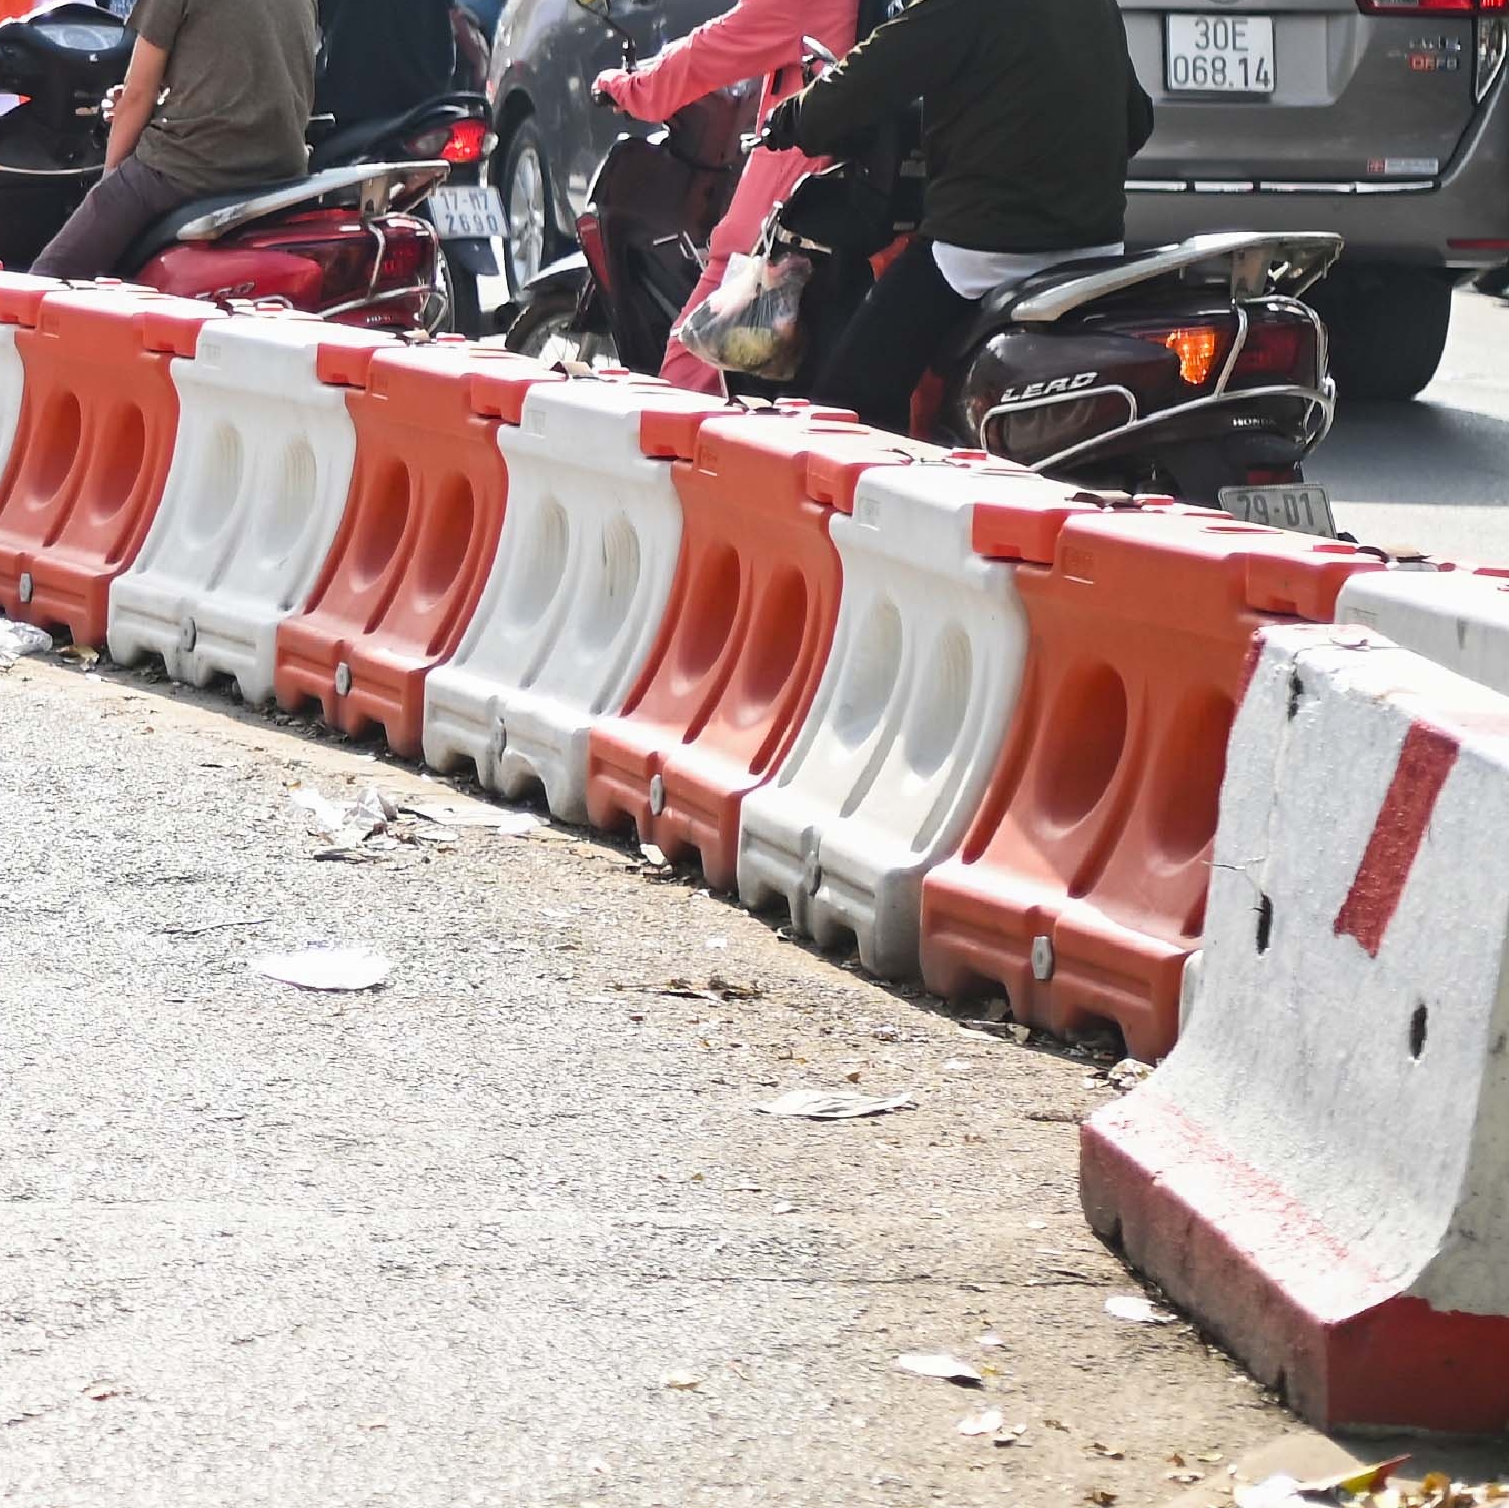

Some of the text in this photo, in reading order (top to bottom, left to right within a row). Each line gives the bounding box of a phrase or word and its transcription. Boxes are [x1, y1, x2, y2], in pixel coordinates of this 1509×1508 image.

[1195, 18, 1249, 51] 30E
[1173, 55, 1271, 89] 068.14
[1000, 372, 1099, 402] LEAD
[1232, 418, 1278, 428] HONDA
